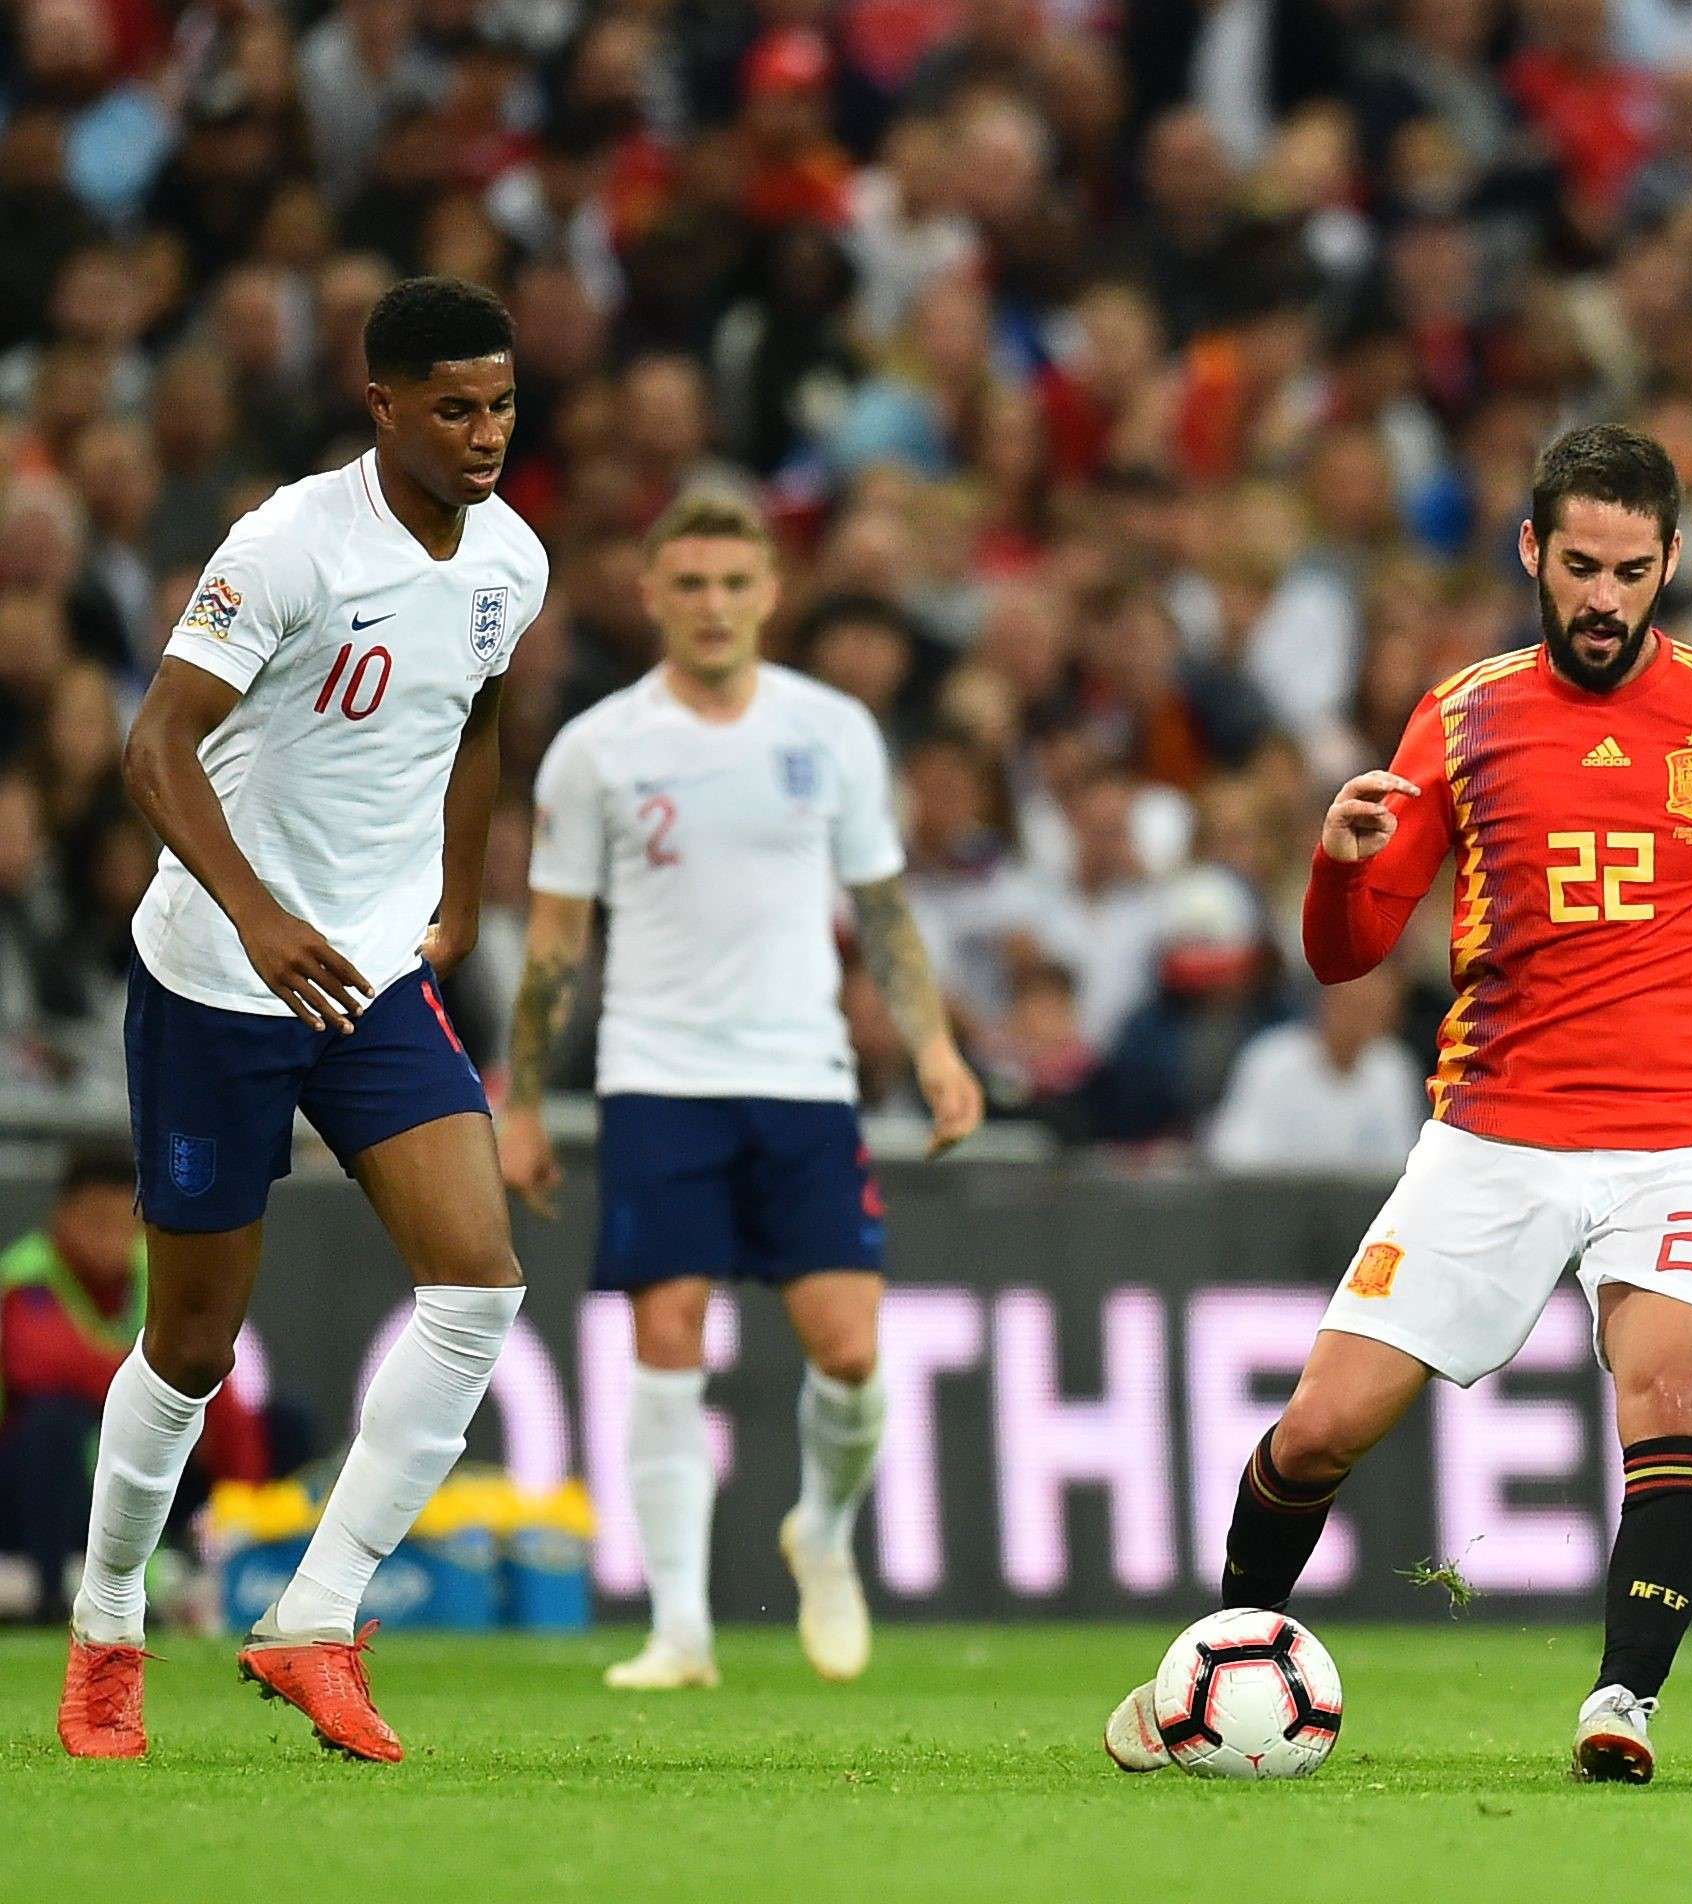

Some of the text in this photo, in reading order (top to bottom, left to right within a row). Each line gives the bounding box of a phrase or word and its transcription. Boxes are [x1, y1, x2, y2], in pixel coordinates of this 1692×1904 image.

[314, 642, 393, 721] 10
[1581, 757, 1631, 767] adidas
[637, 795, 682, 870] 2
[1547, 831, 1655, 923] 22
[875, 1286, 1360, 1598] THE
[1629, 1580, 1689, 1610] AFEF
